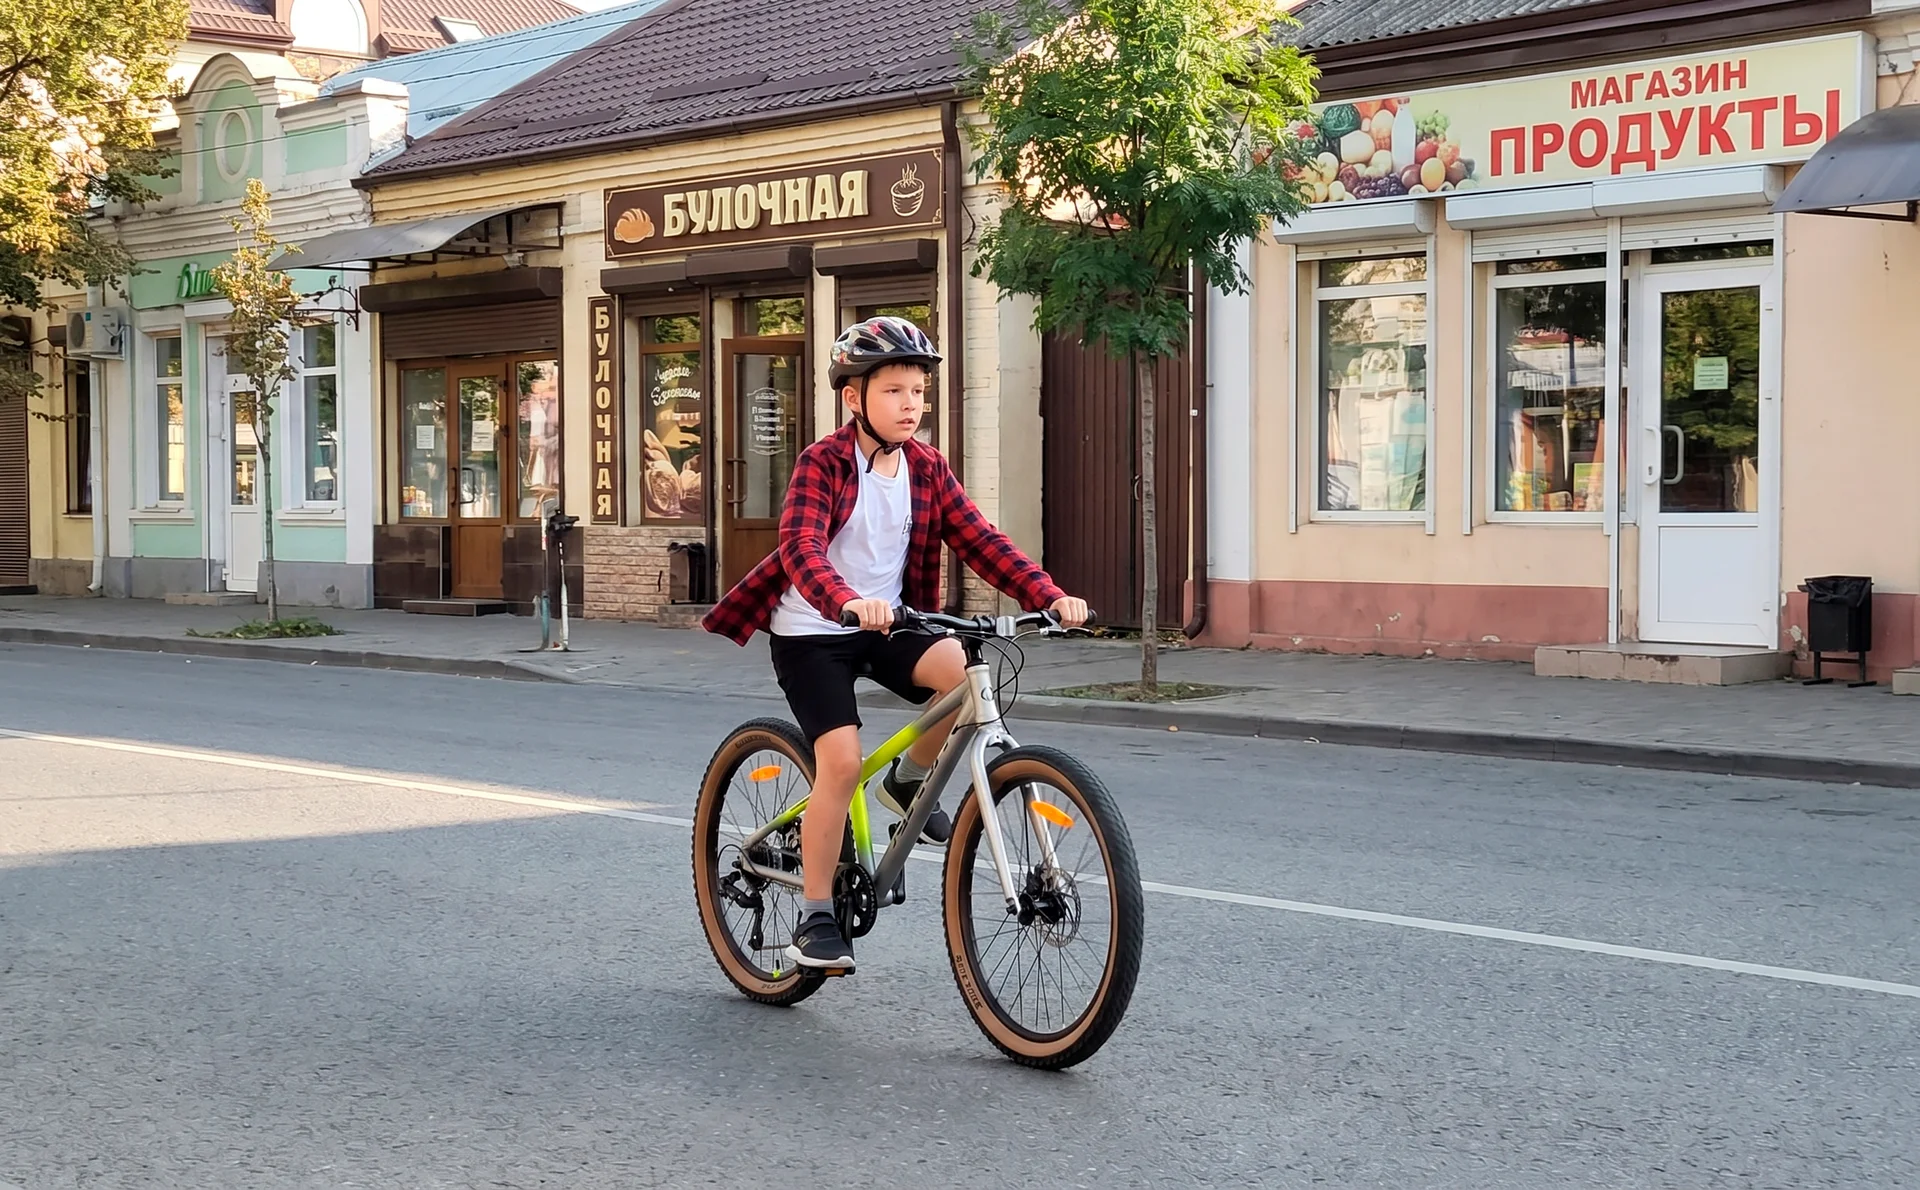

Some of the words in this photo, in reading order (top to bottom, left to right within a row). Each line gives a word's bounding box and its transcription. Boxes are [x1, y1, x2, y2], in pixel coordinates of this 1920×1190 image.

[1570, 59, 1748, 109] МАГАЗИН
[1489, 88, 1841, 178] ПРОДУКТЫ
[662, 169, 869, 238] БУЛОЧНАЯ
[594, 305, 612, 517] БУЛОЧНАЯ
